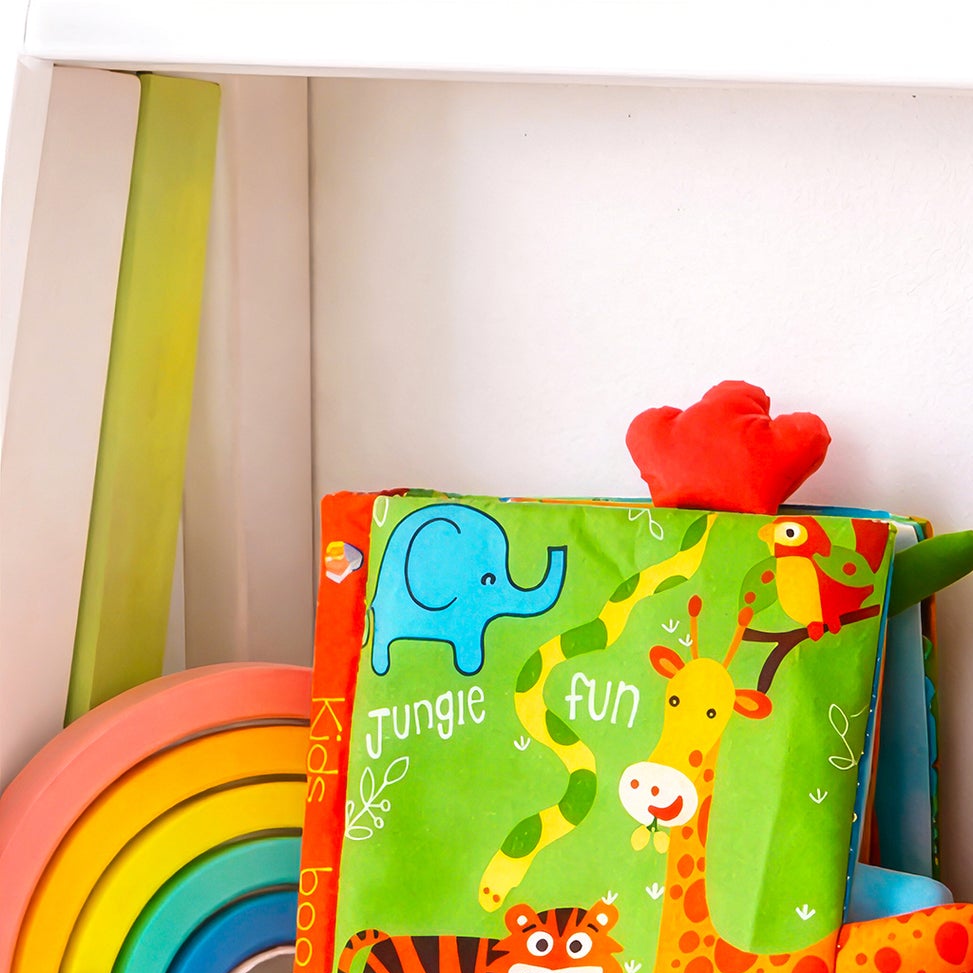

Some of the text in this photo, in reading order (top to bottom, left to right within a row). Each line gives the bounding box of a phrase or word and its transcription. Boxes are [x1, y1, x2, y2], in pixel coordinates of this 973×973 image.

[306, 697, 346, 803] Kids
[365, 671, 641, 760] Jungle fun
